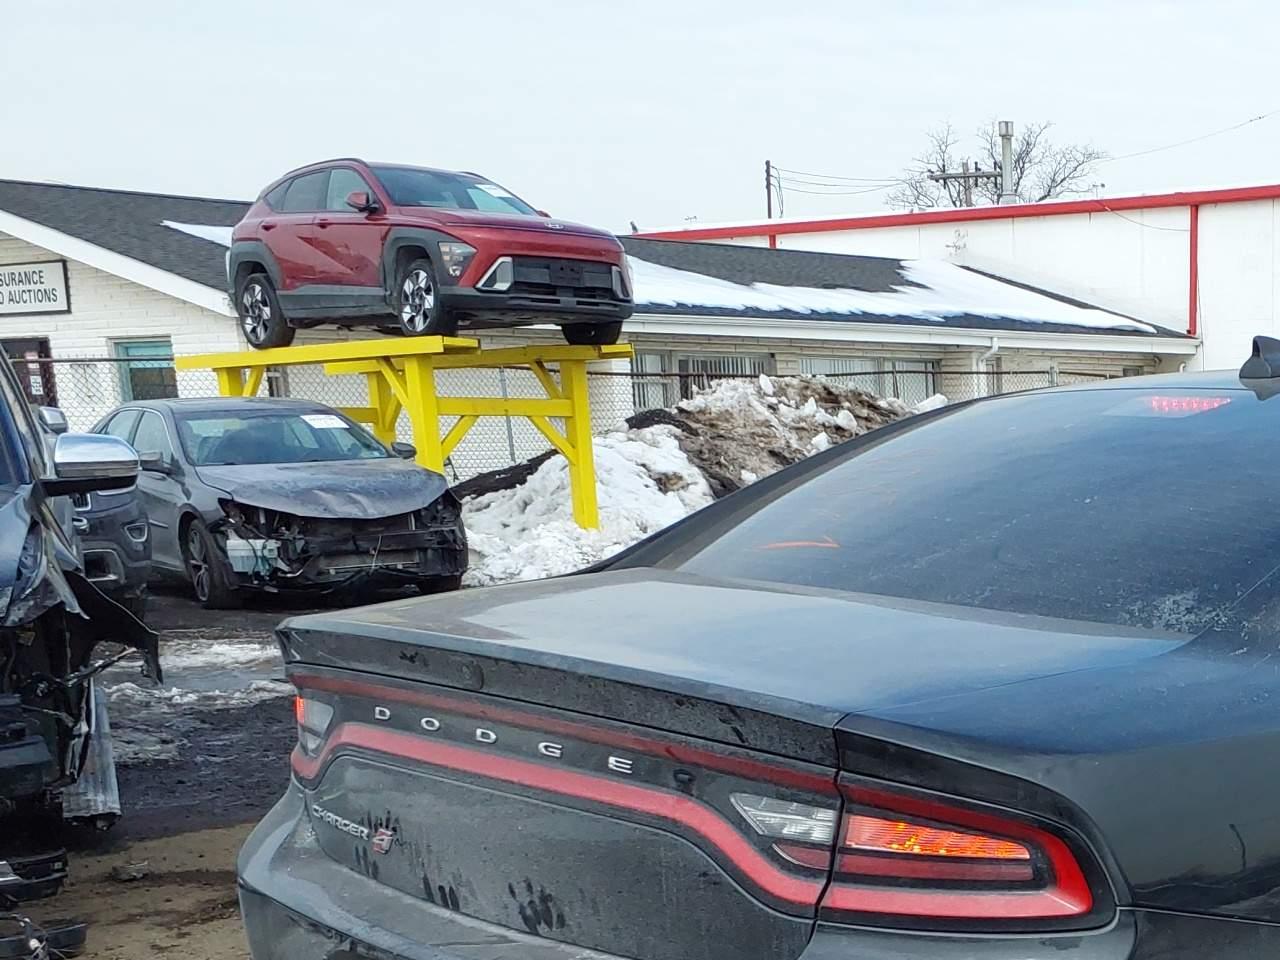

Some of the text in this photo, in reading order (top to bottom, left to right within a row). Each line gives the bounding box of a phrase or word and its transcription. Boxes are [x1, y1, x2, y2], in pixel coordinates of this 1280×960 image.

[8, 288, 58, 304] AUCTIONS
[375, 707, 633, 774] DODGE
[312, 804, 369, 841] CHARGER
